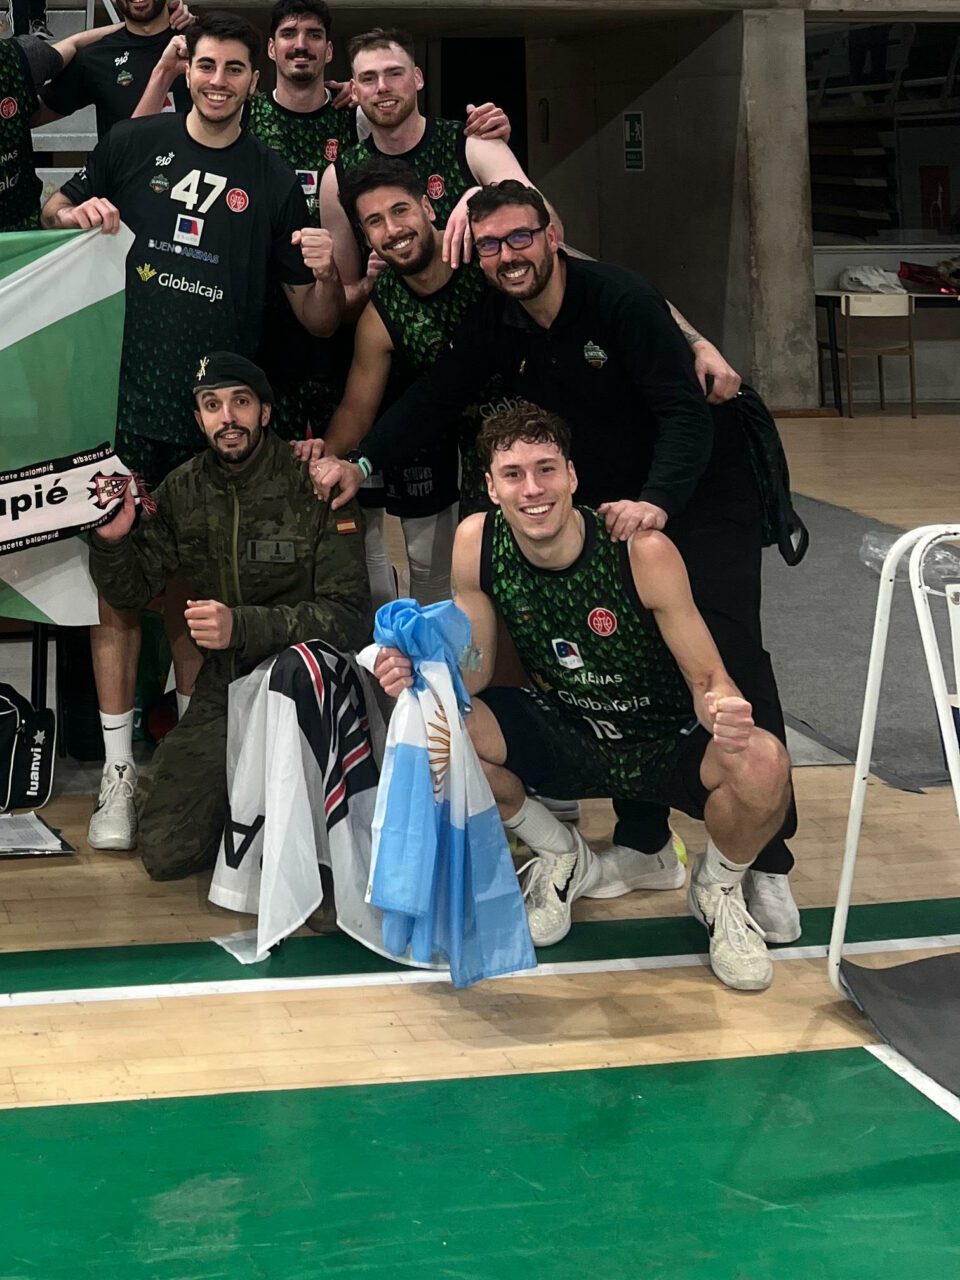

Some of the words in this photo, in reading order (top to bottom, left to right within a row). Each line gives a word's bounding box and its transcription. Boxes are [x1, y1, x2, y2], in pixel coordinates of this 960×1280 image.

[170, 169, 228, 214] 47
[158, 272, 224, 303] Globalcaja
[582, 715, 624, 740] 10
[26, 747, 43, 797] luanvi
